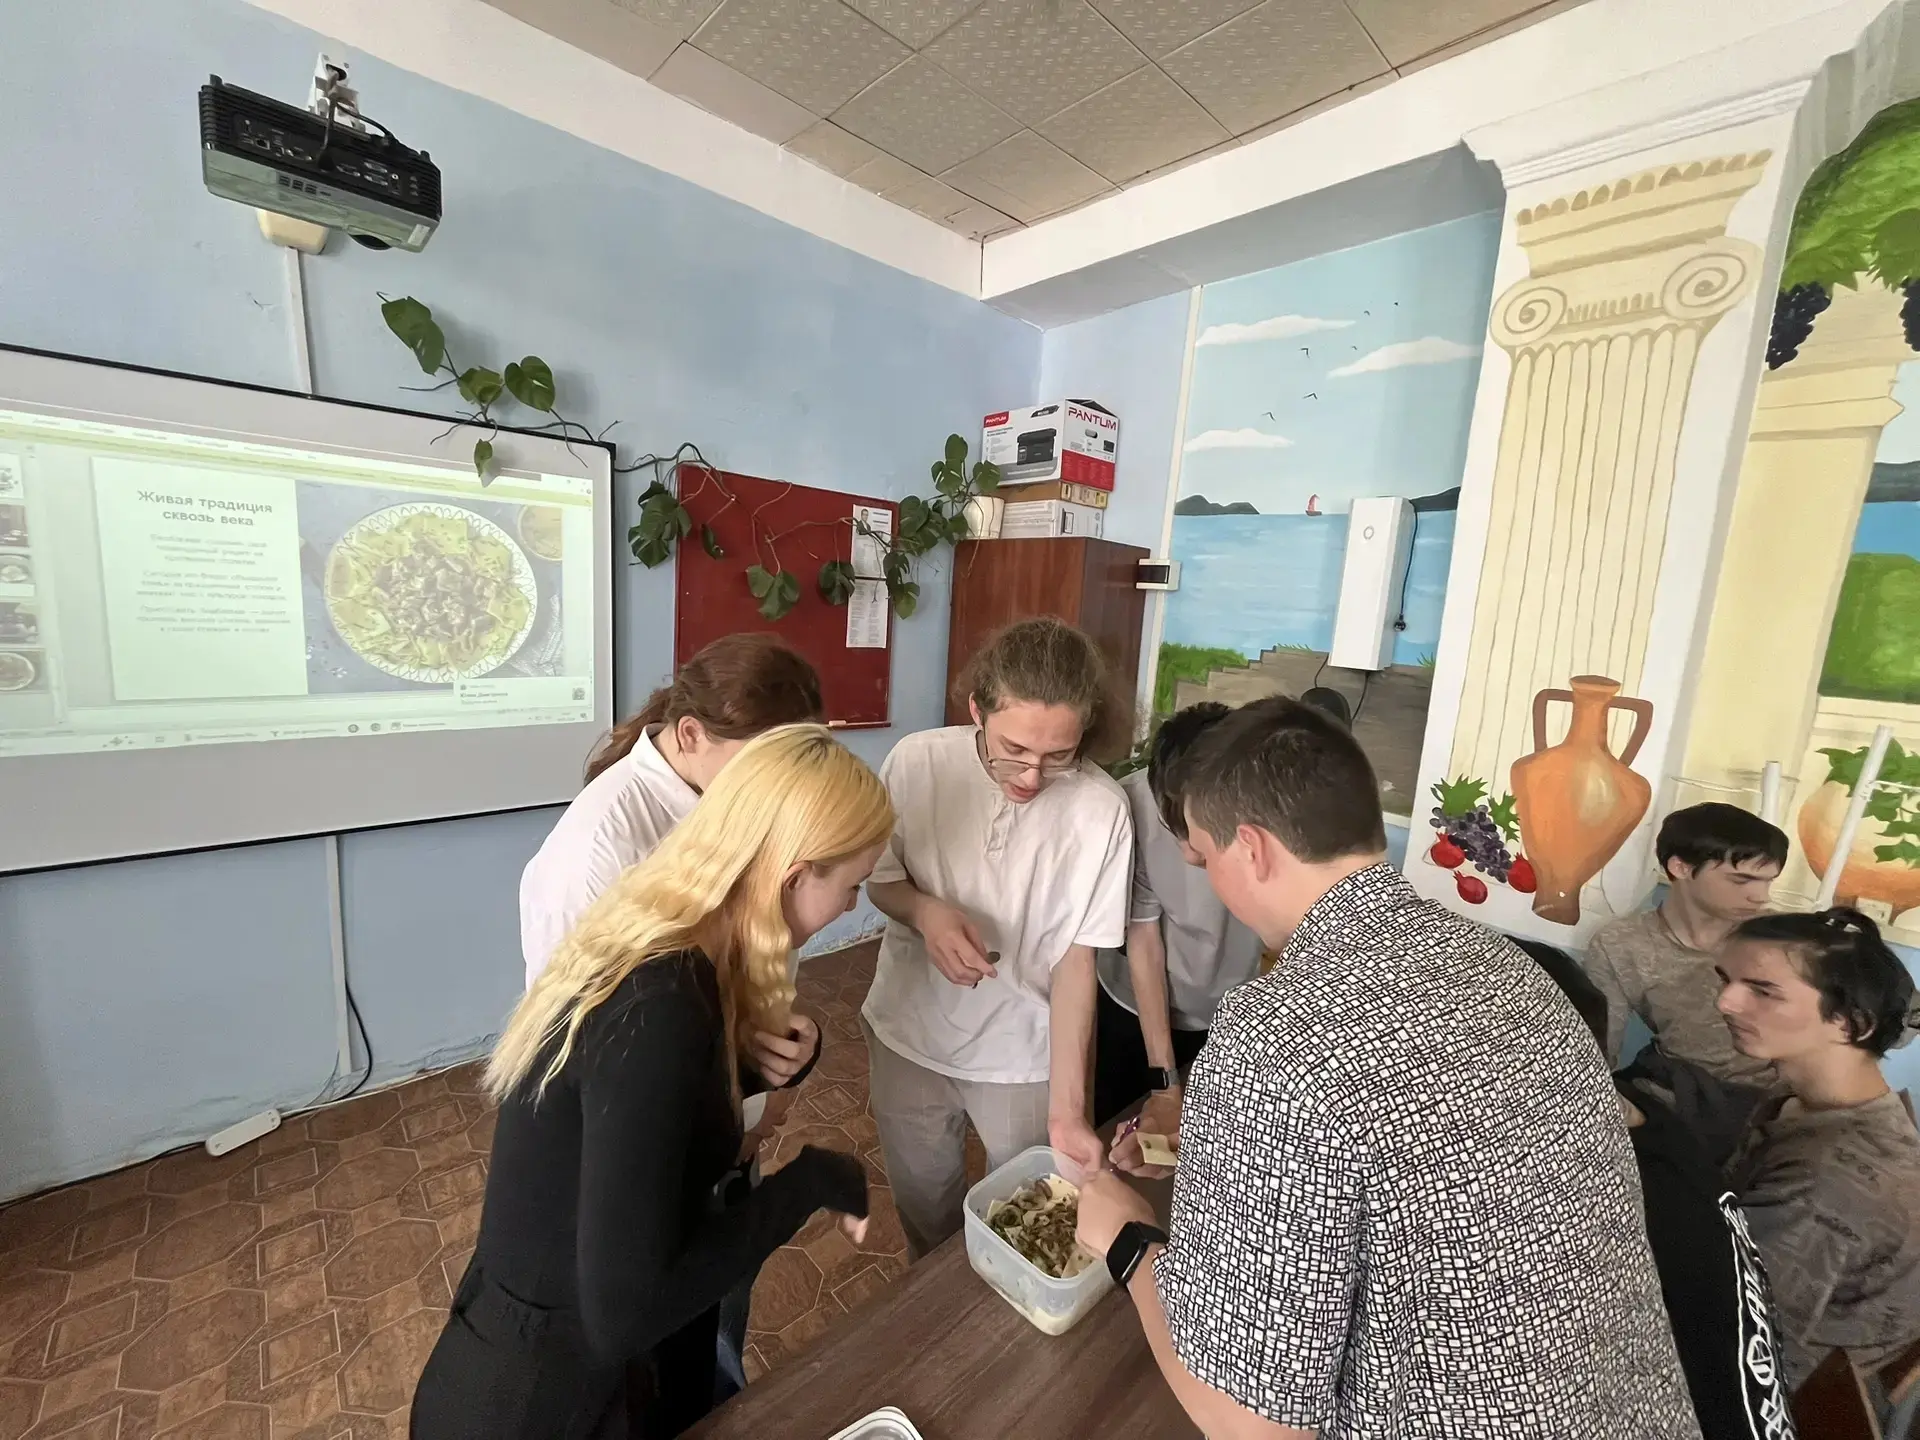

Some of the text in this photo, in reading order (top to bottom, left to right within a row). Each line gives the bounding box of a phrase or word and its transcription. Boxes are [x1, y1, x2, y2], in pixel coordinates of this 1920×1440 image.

[1068, 406, 1117, 431] PANTUM
[137, 490, 273, 514] Живая традиция
[162, 510, 254, 526] сквозь века
